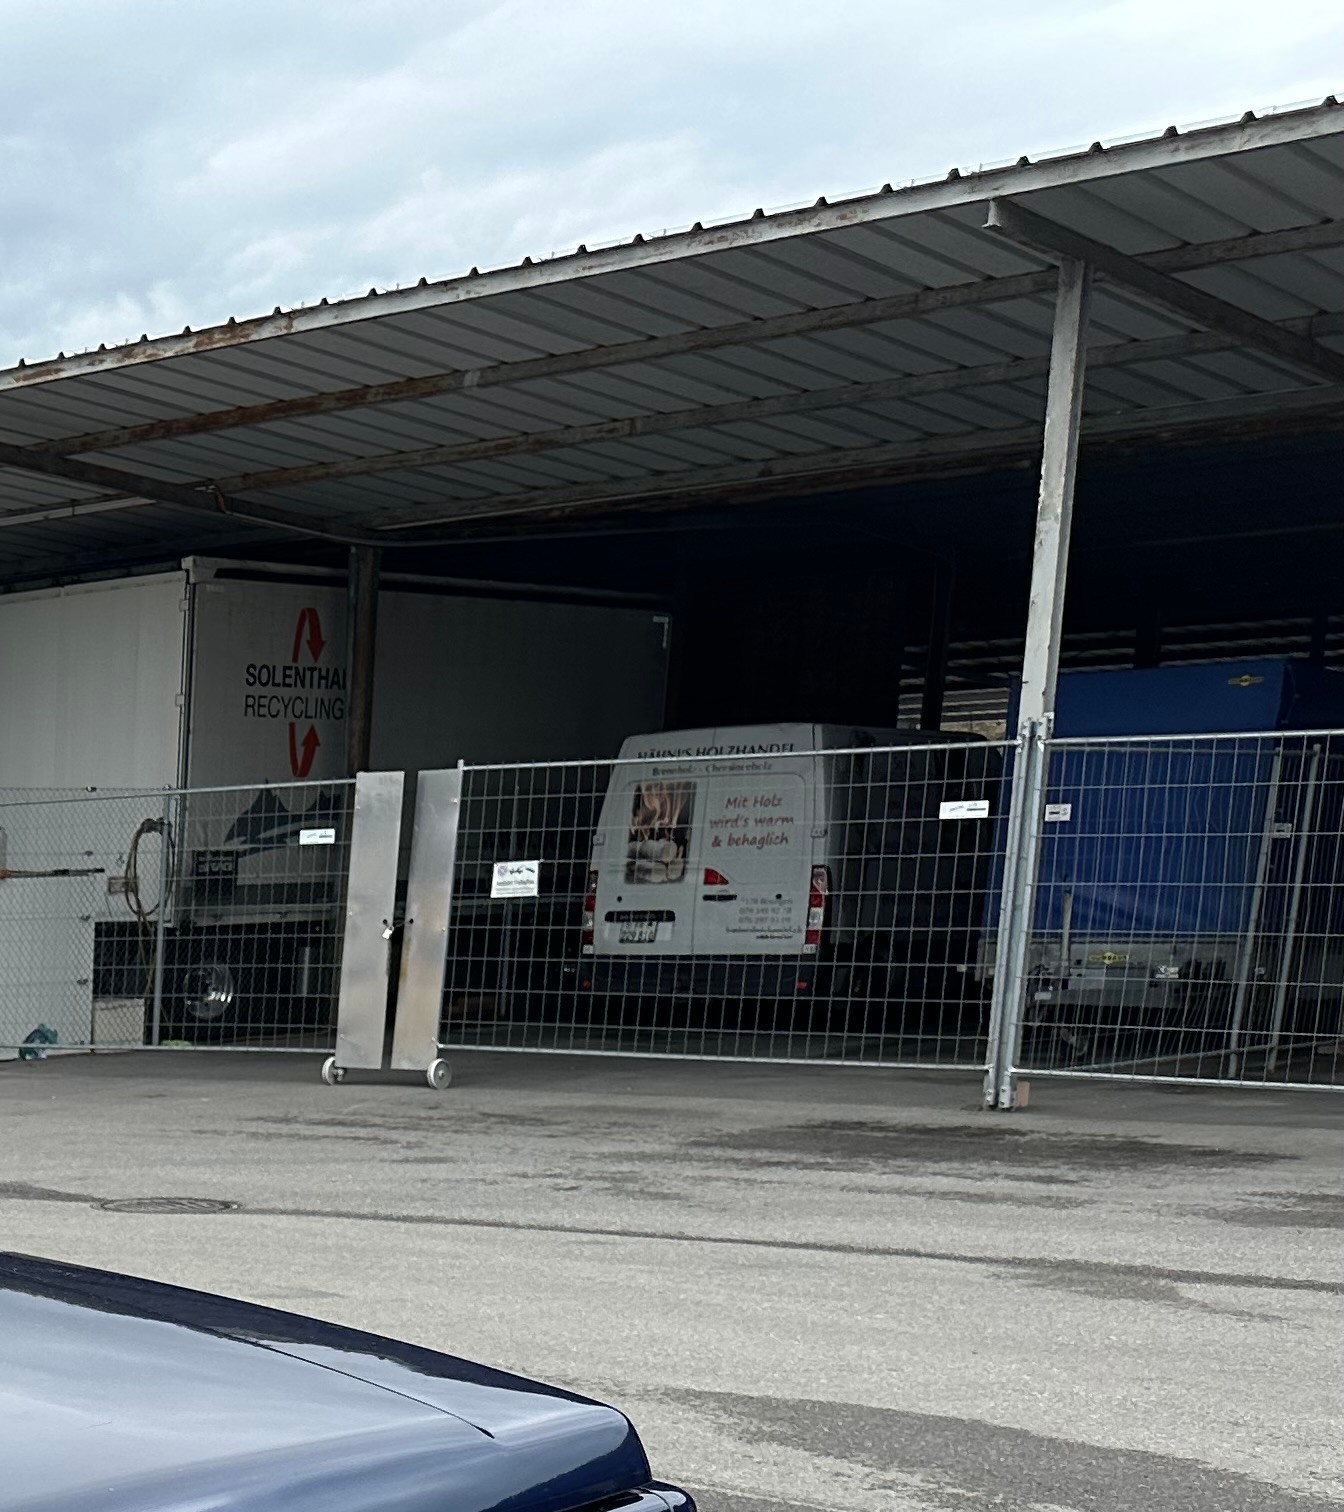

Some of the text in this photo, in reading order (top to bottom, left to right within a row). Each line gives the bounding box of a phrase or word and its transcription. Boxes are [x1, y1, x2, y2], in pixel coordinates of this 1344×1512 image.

[244, 695, 344, 720] RECYCLING
[725, 794, 783, 809] Mit Holz
[710, 815, 794, 829] wird's warm
[712, 832, 788, 850] & behaglich
